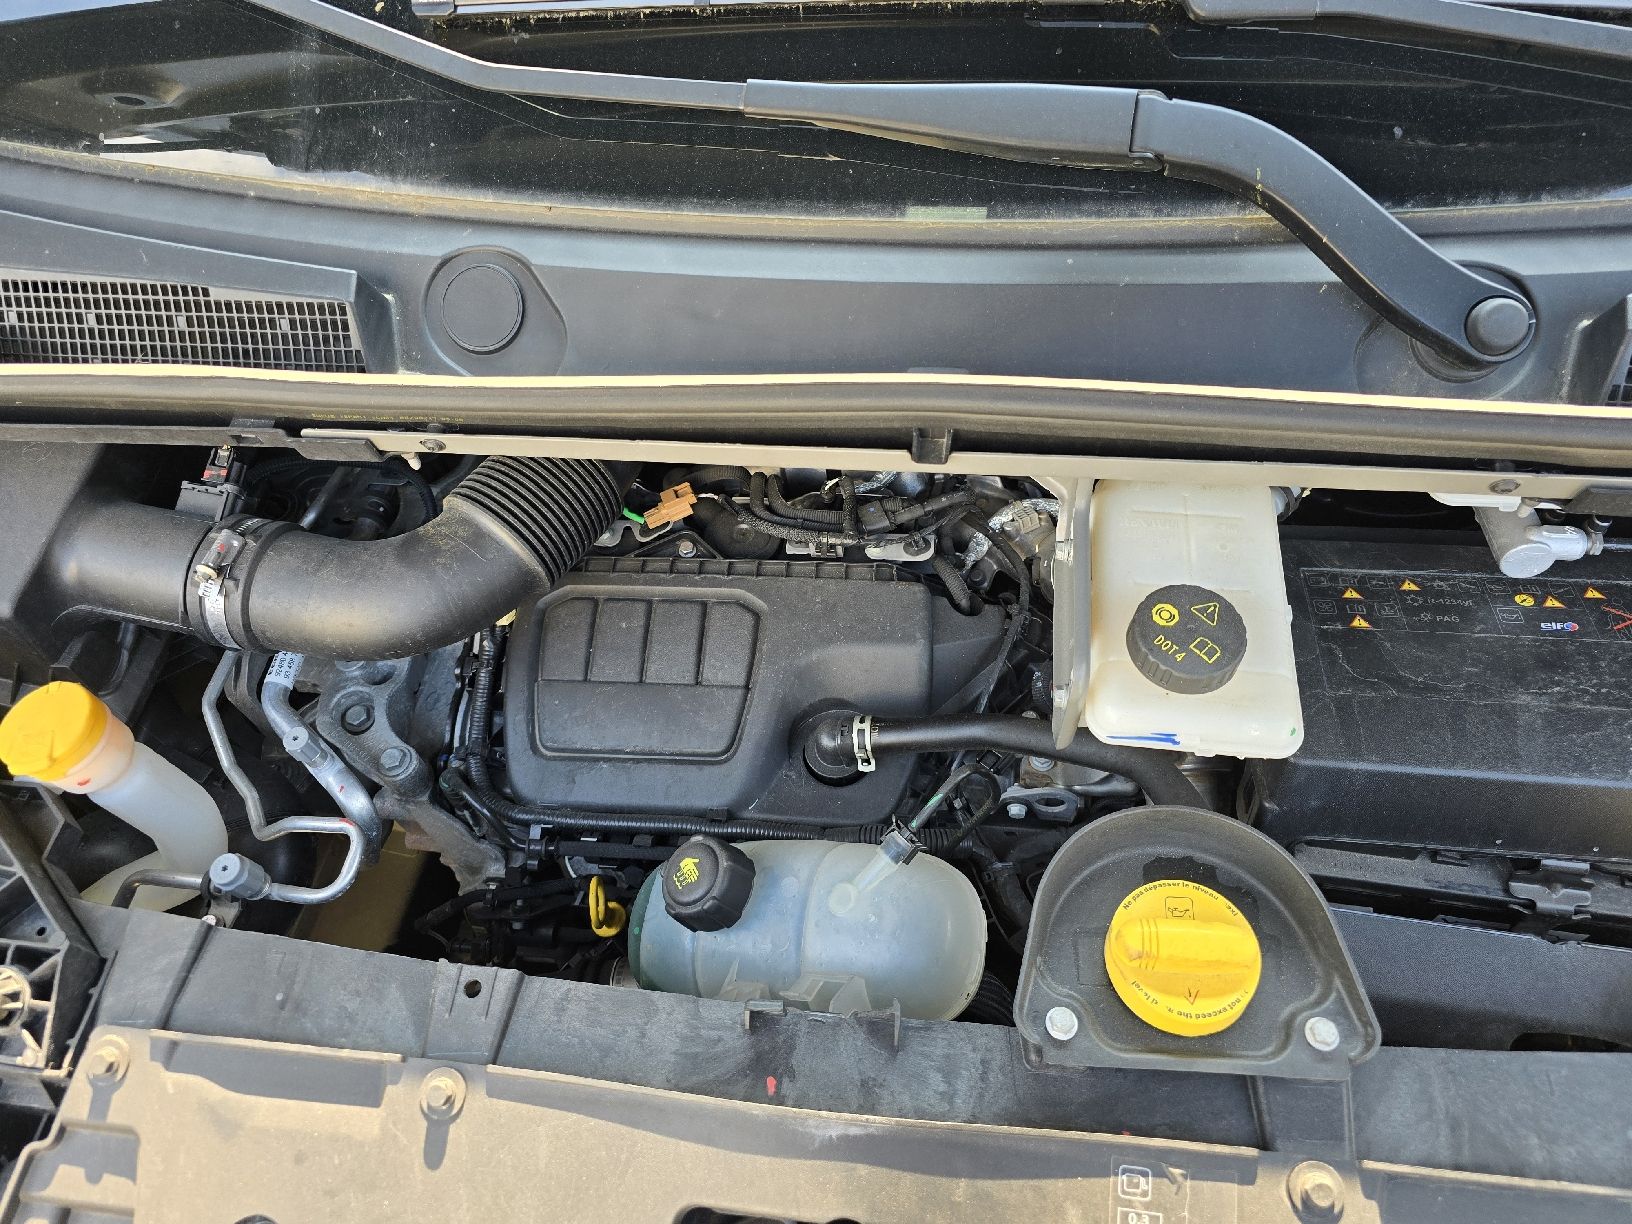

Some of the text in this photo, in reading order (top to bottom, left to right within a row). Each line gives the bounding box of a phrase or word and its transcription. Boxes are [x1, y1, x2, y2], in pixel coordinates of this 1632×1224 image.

[1436, 615, 1460, 623] PAG
[1153, 634, 1187, 662] DOT 4
[1122, 900, 1132, 911] Ne
[1132, 890, 1144, 902] pas
[1182, 881, 1190, 889] le
[1192, 884, 1219, 901] niveau
[1177, 1010, 1193, 1019] the
[1195, 1006, 1228, 1020] exceed
